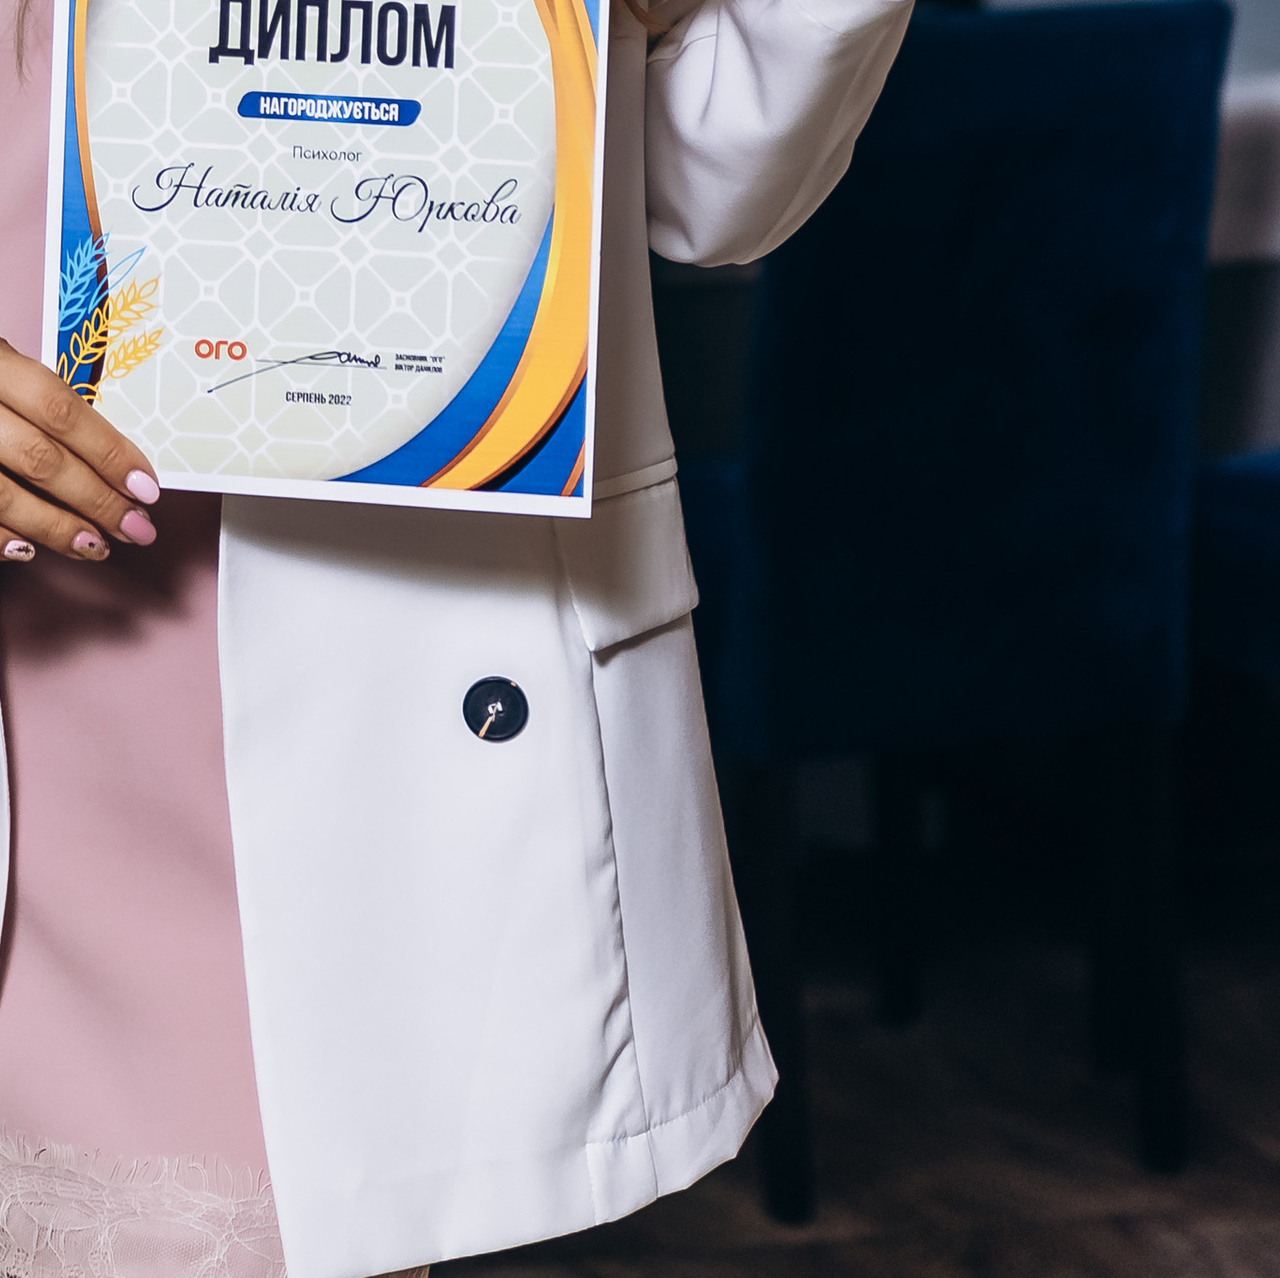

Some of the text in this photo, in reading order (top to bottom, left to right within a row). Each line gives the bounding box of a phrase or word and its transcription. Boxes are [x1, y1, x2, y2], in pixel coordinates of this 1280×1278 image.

[259, 95, 400, 123] НАГОРОДЖУЄТЬСЯ
[292, 145, 363, 163] Психолог
[131, 162, 523, 233] Наталія Юркова
[285, 391, 352, 406] СЕРПЕНЬ 2022
